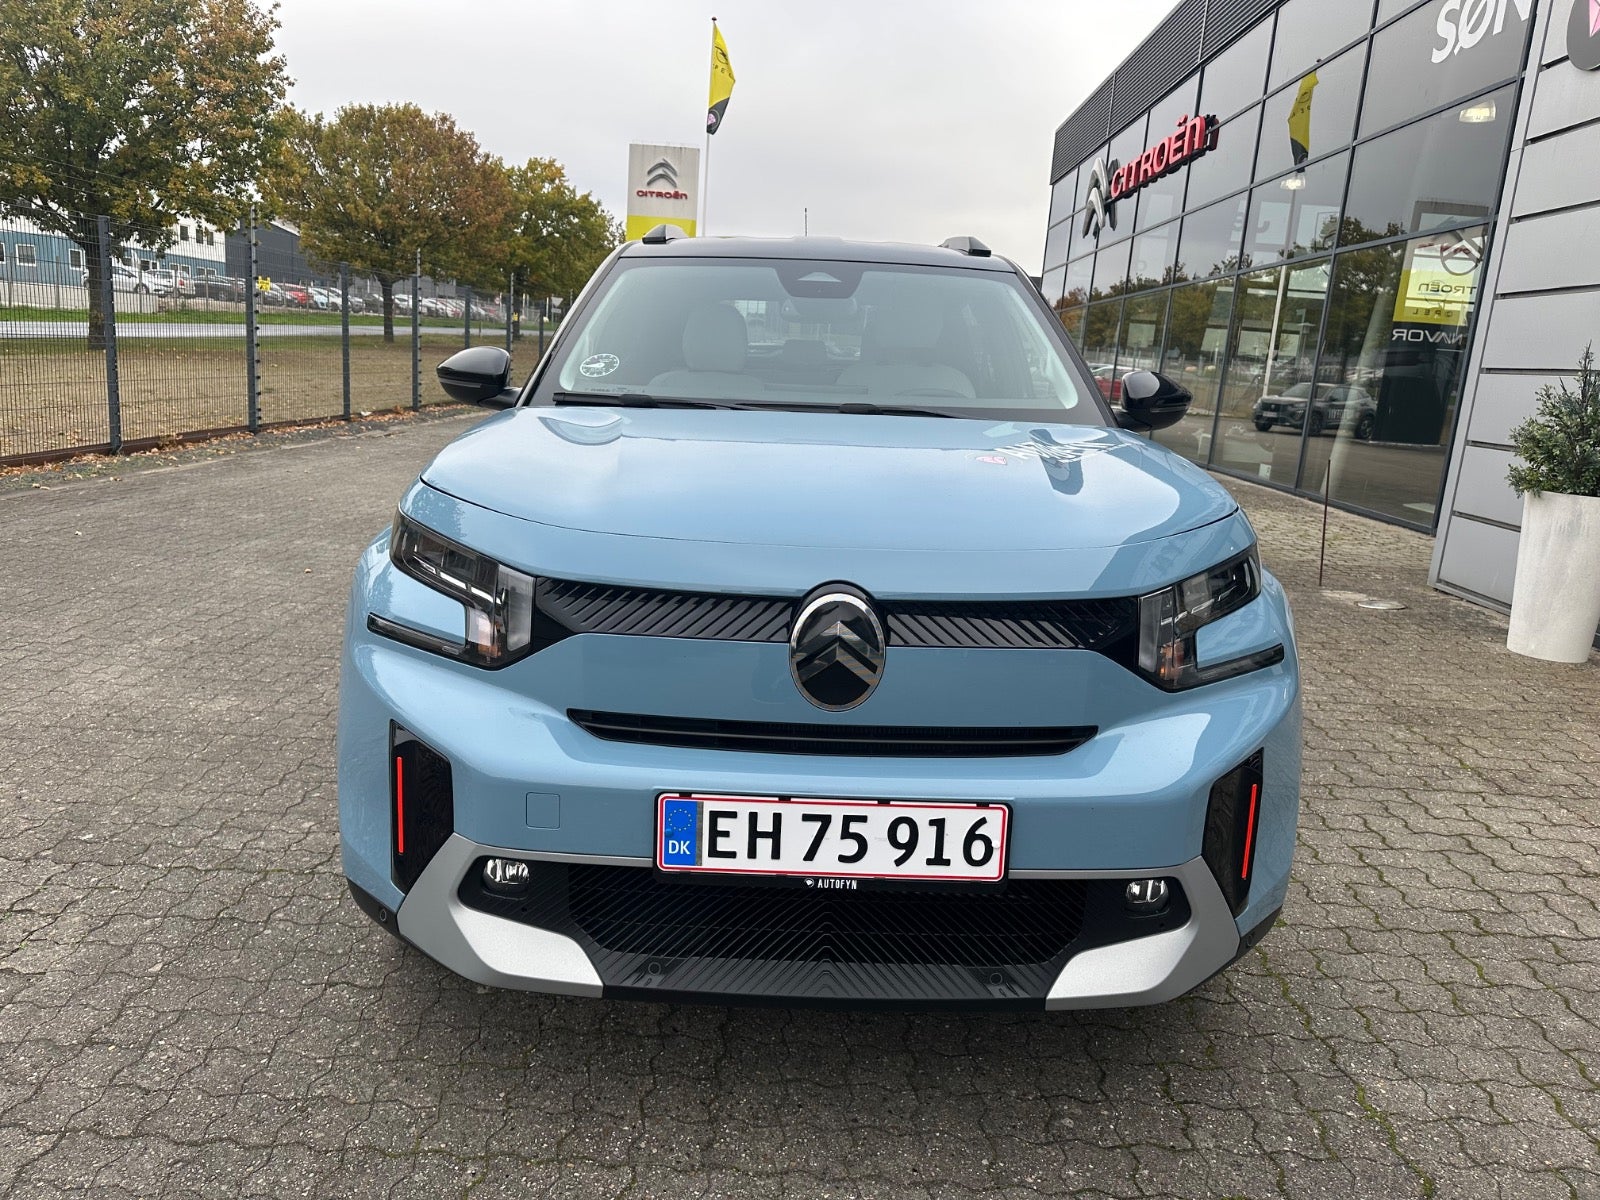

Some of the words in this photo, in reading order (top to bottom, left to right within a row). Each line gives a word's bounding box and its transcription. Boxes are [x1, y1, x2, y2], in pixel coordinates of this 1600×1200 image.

[1111, 115, 1207, 199] CITROËN
[636, 190, 688, 200] CITROËN
[707, 809, 782, 860] EH
[801, 813, 868, 864] 75
[887, 816, 995, 868] 916
[668, 840, 690, 855] DK
[817, 879, 858, 890] AUTOFYN
